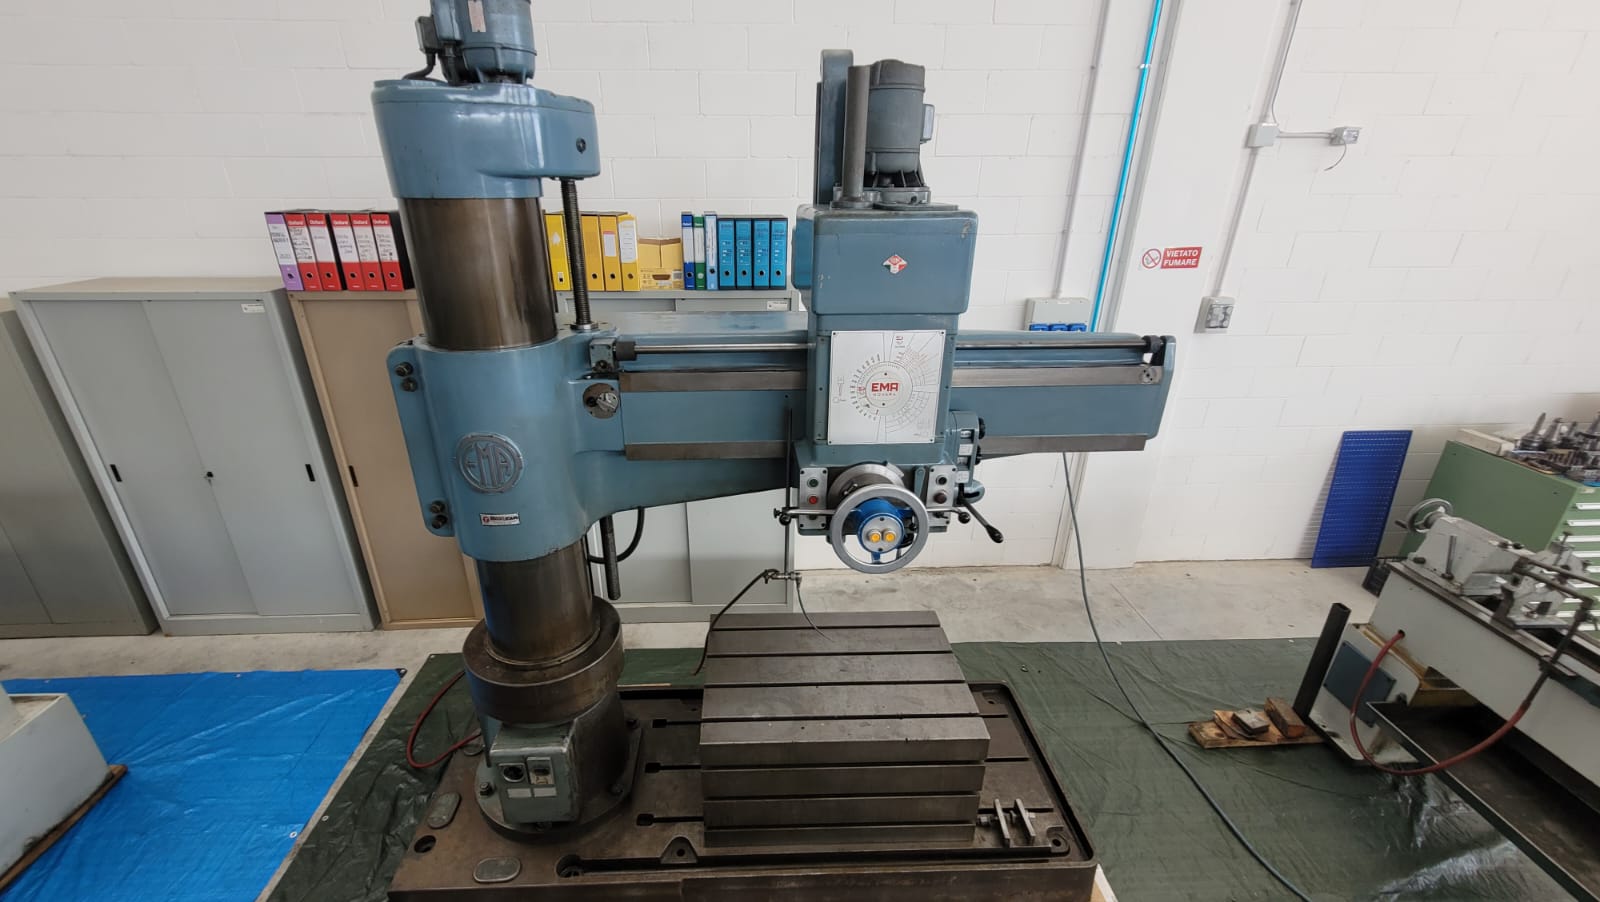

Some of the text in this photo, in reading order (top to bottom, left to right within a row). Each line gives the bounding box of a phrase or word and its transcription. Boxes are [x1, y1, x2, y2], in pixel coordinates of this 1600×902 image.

[1166, 249, 1198, 257] VIETATO
[1163, 258, 1197, 266] FUMARE
[872, 383, 898, 392] EMA
